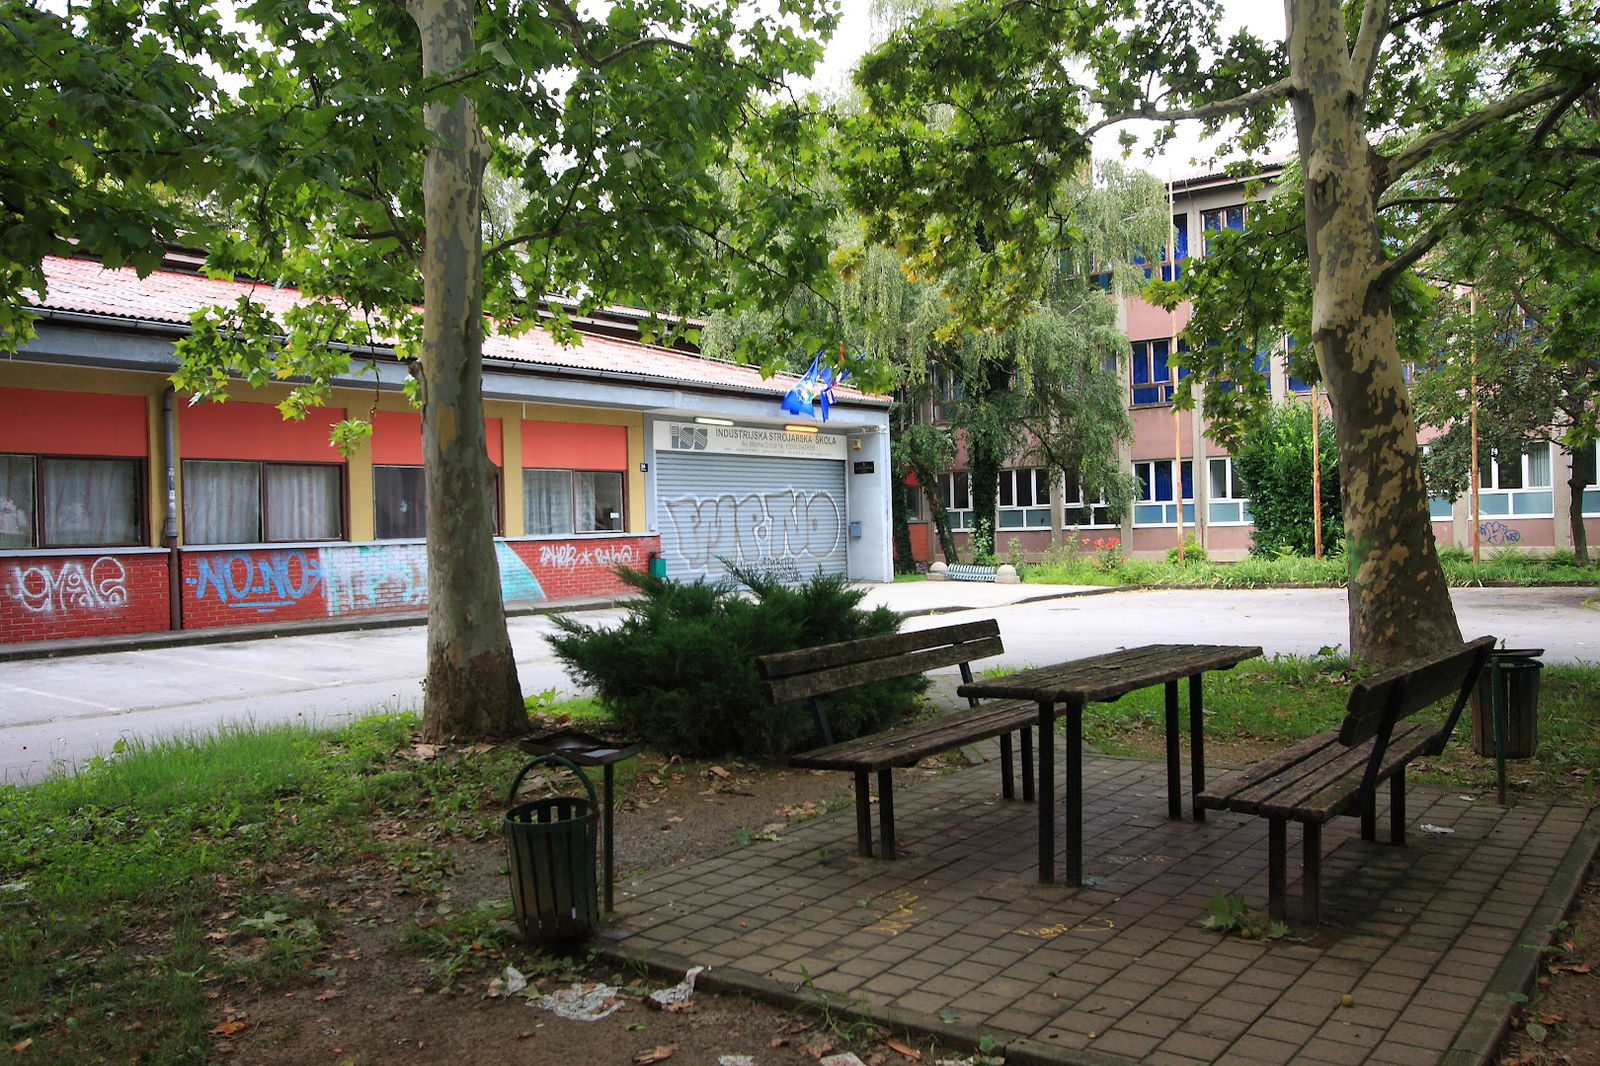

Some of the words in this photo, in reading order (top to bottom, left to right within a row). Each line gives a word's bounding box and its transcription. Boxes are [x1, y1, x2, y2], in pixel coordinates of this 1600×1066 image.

[715, 428, 768, 440] INDUSTRIJSKA
[769, 432, 813, 443] STROJARSKA
[815, 433, 837, 445] ŠKOLA
